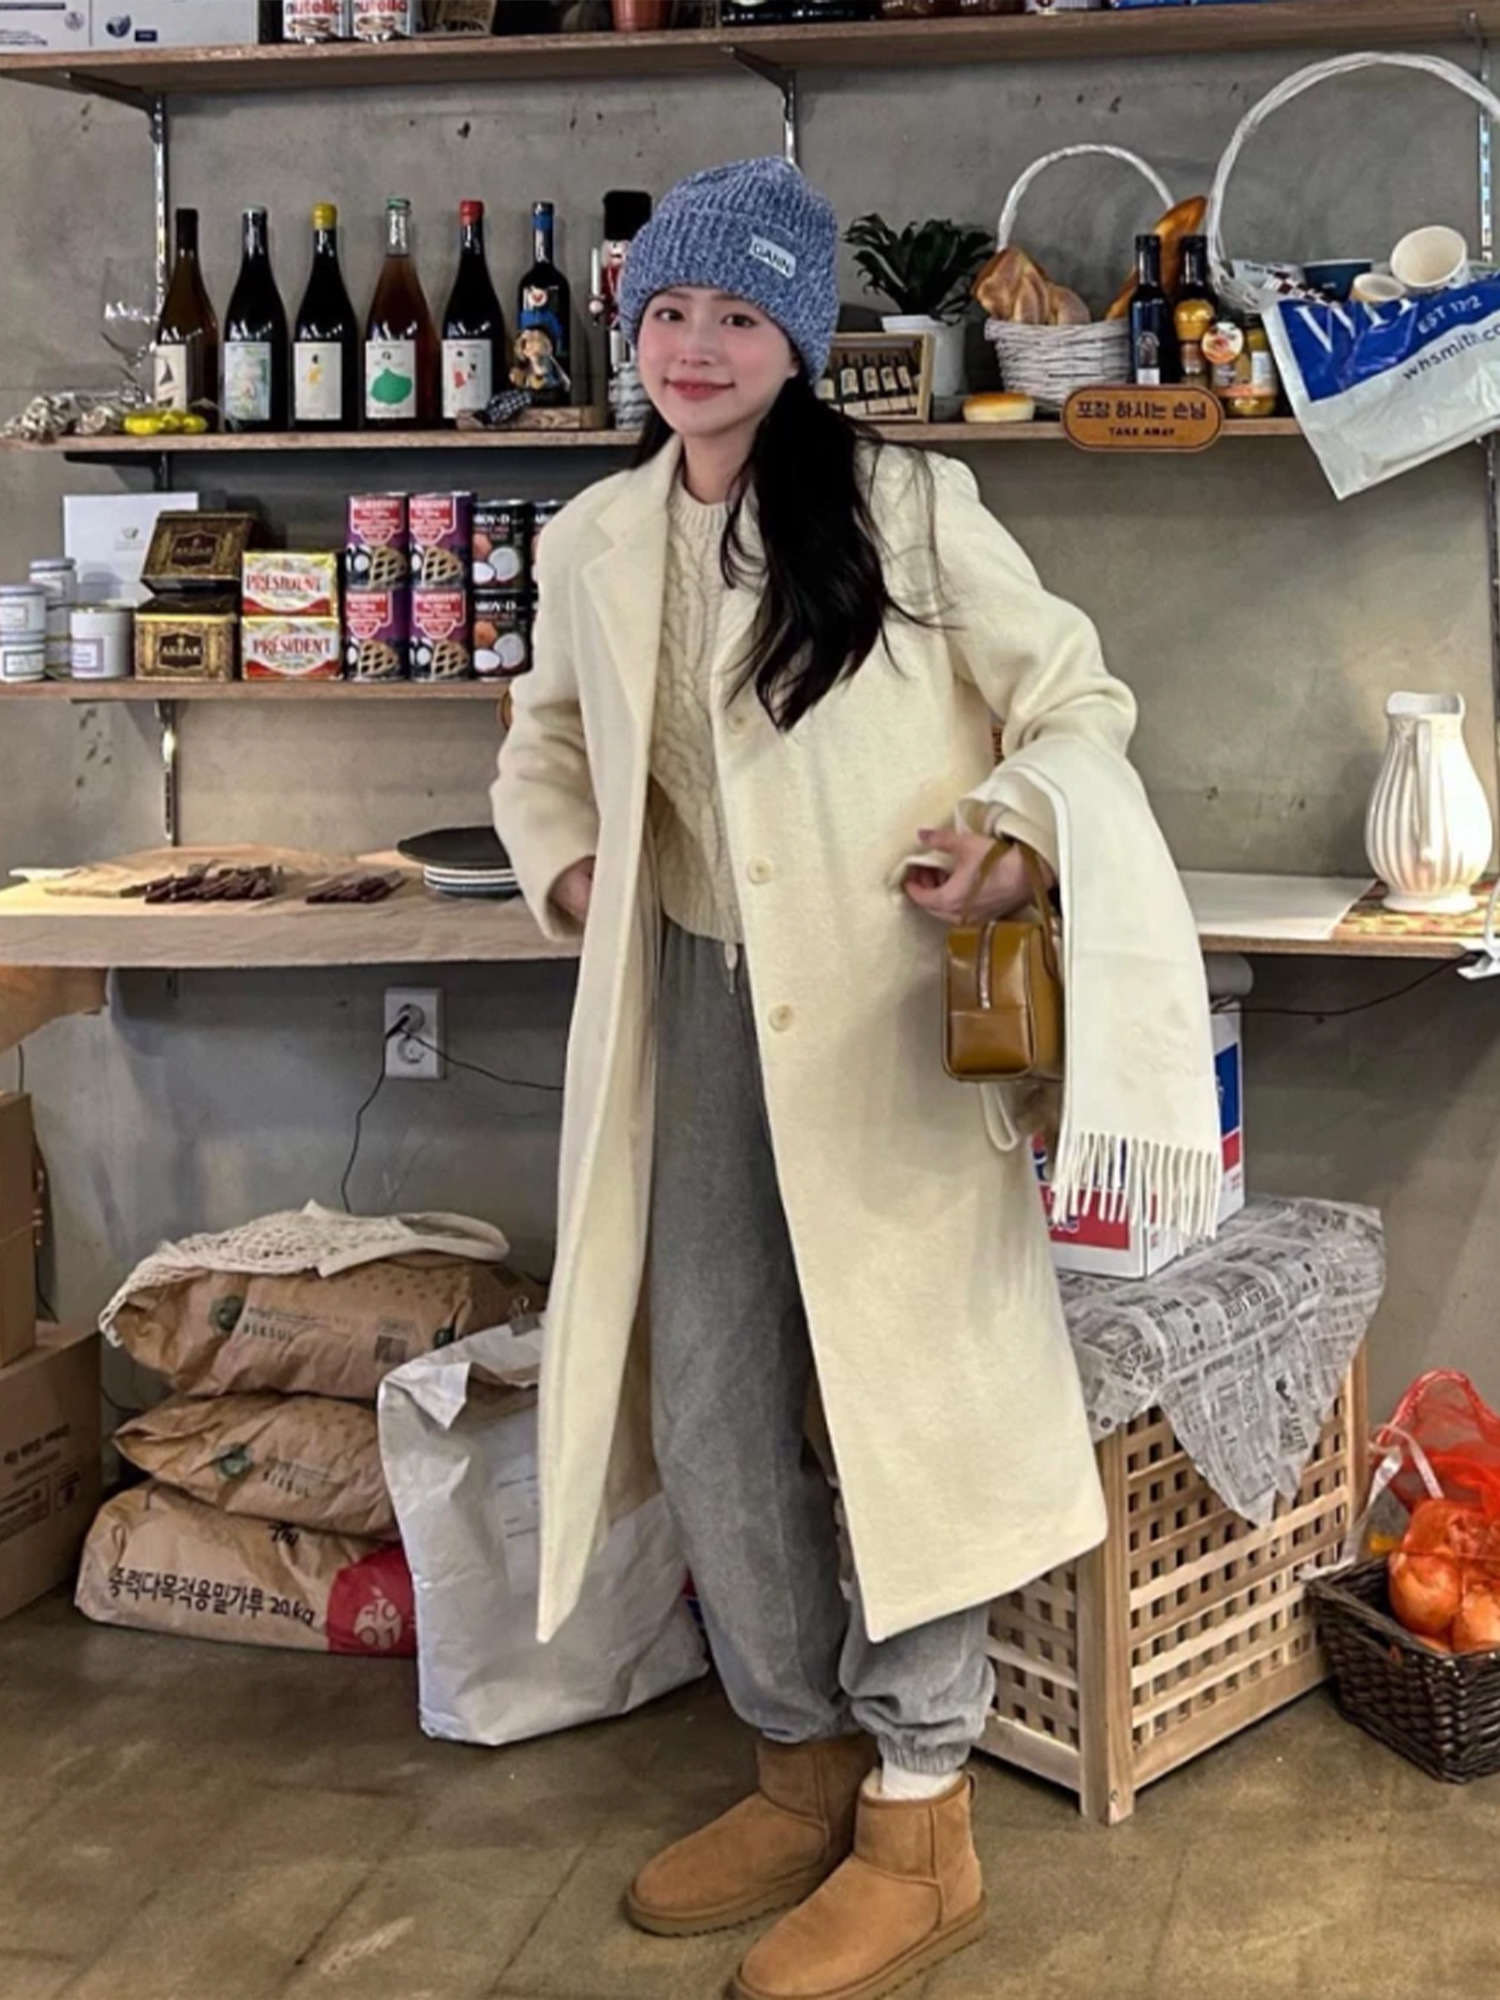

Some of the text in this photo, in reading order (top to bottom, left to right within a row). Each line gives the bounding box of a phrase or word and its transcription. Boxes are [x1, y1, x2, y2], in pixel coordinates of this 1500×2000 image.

[1417, 305, 1447, 334] EST
[1076, 401, 1206, 420] 포장 하시는 손님
[1108, 427, 1175, 436] TAKE AWAY
[108, 1567, 264, 1618] 중력다목적용밀가루
